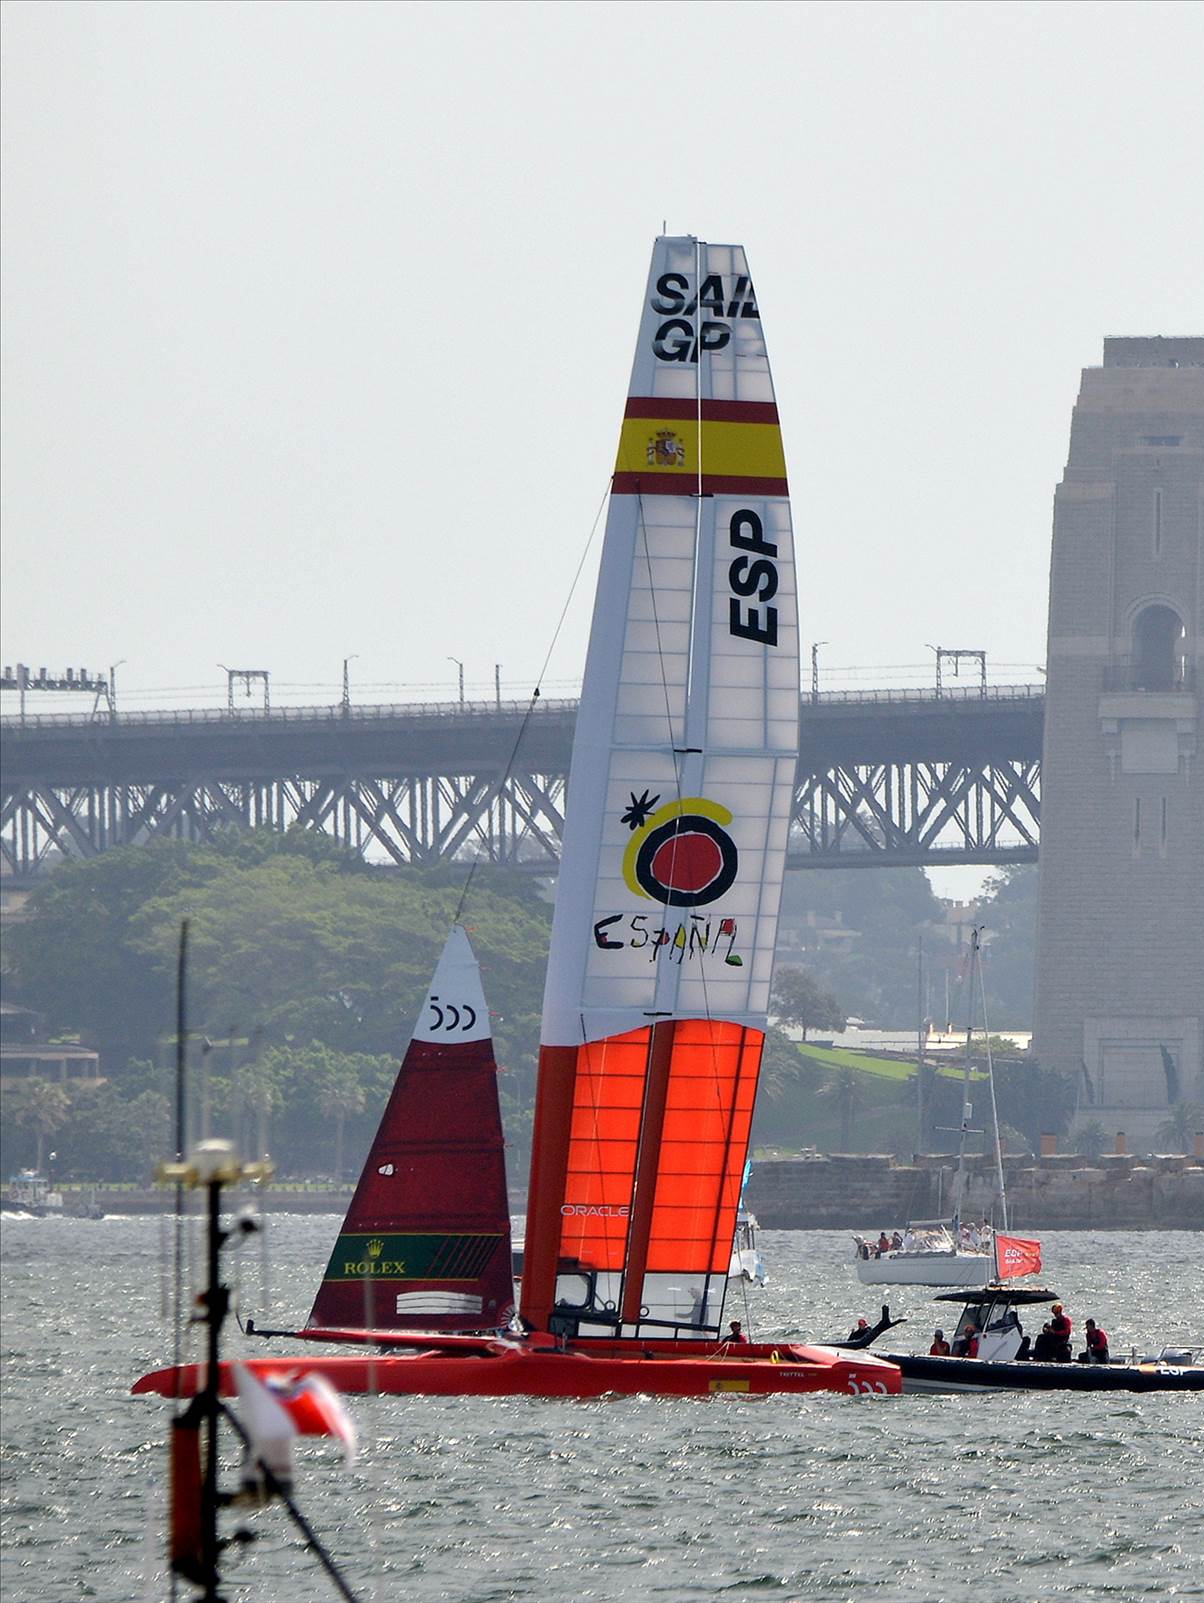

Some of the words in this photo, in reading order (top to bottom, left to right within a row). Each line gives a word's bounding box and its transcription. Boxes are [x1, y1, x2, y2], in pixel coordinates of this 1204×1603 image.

[652, 319, 731, 363] GP
[729, 508, 778, 646] ESP
[560, 1205, 630, 1217] ORACLE
[344, 1262, 406, 1274] ROLEX
